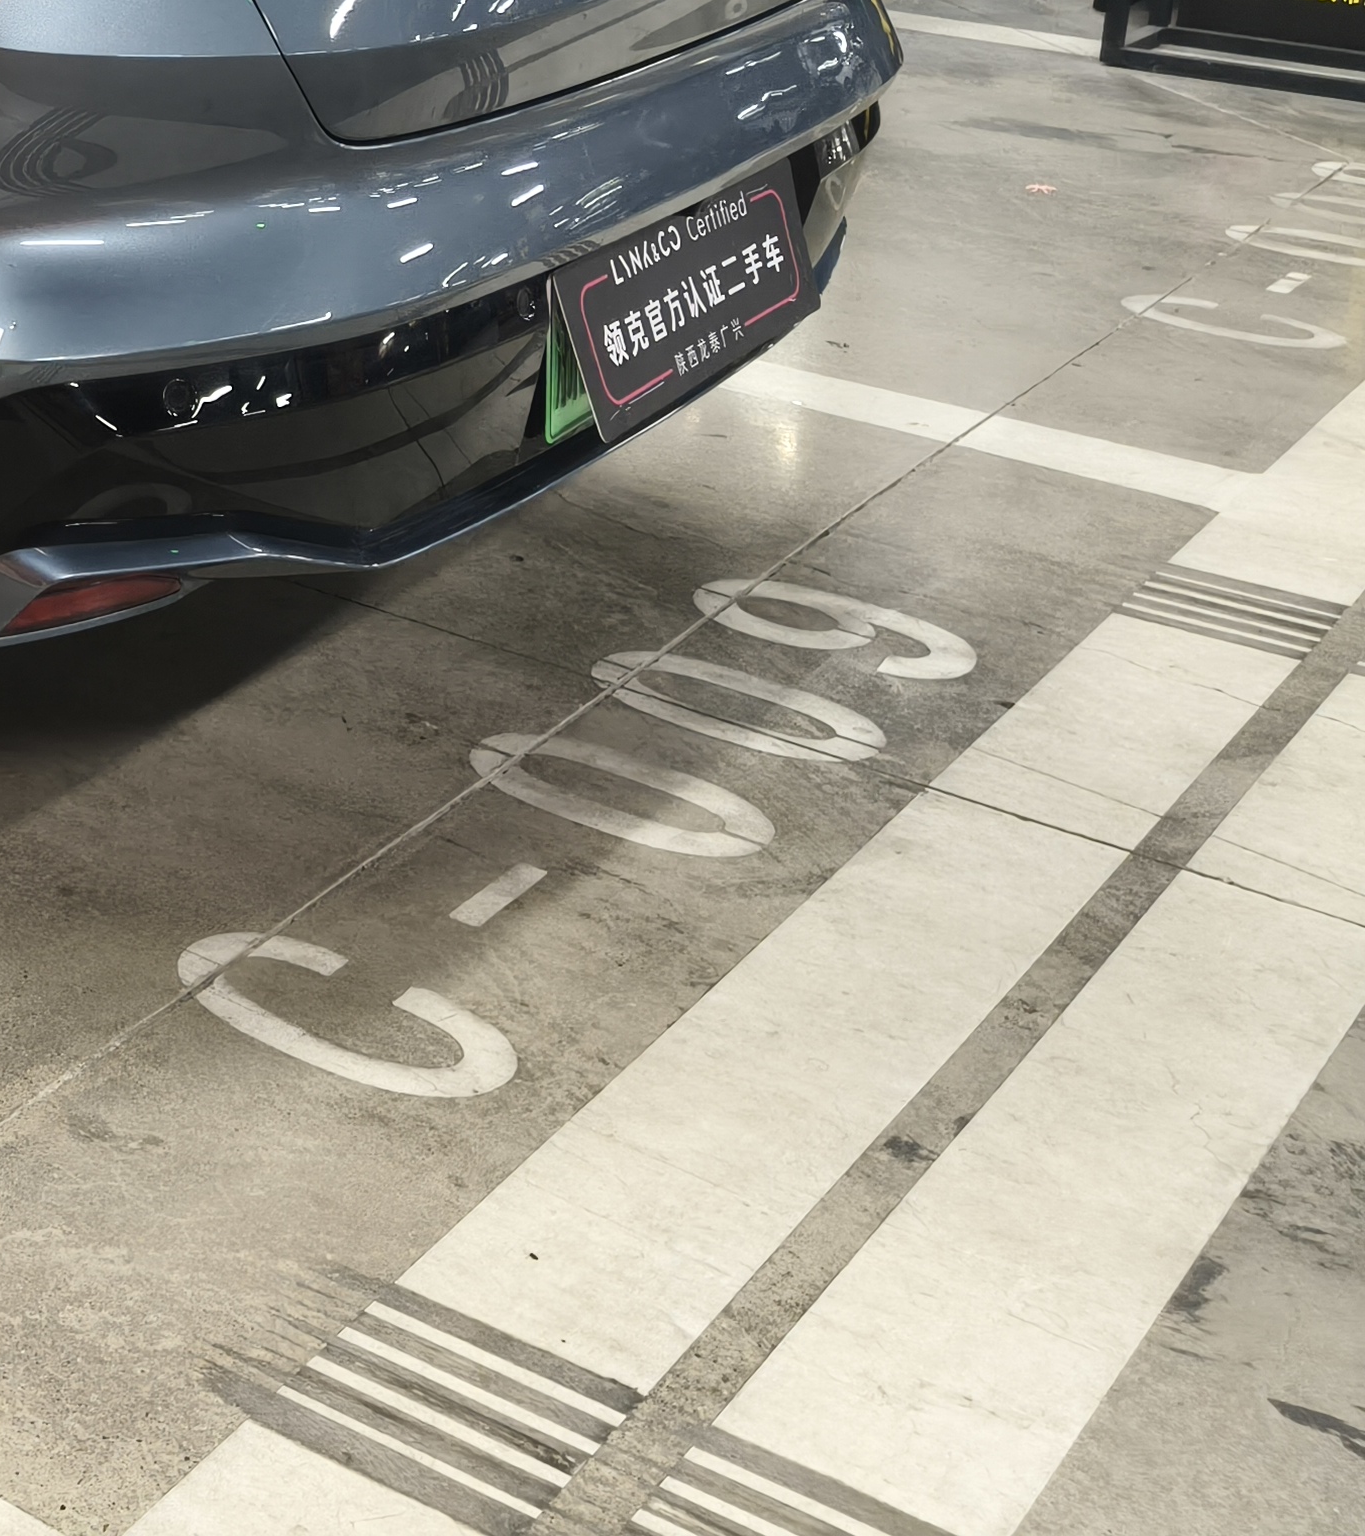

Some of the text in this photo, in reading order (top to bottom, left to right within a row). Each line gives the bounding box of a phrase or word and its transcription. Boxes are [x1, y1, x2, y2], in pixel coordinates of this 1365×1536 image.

[685, 190, 748, 242] Certified
[602, 233, 785, 368] 领克官方认证二手车
[673, 317, 745, 377] 陕西龙泰广兴
[176, 578, 978, 1098] C-009
